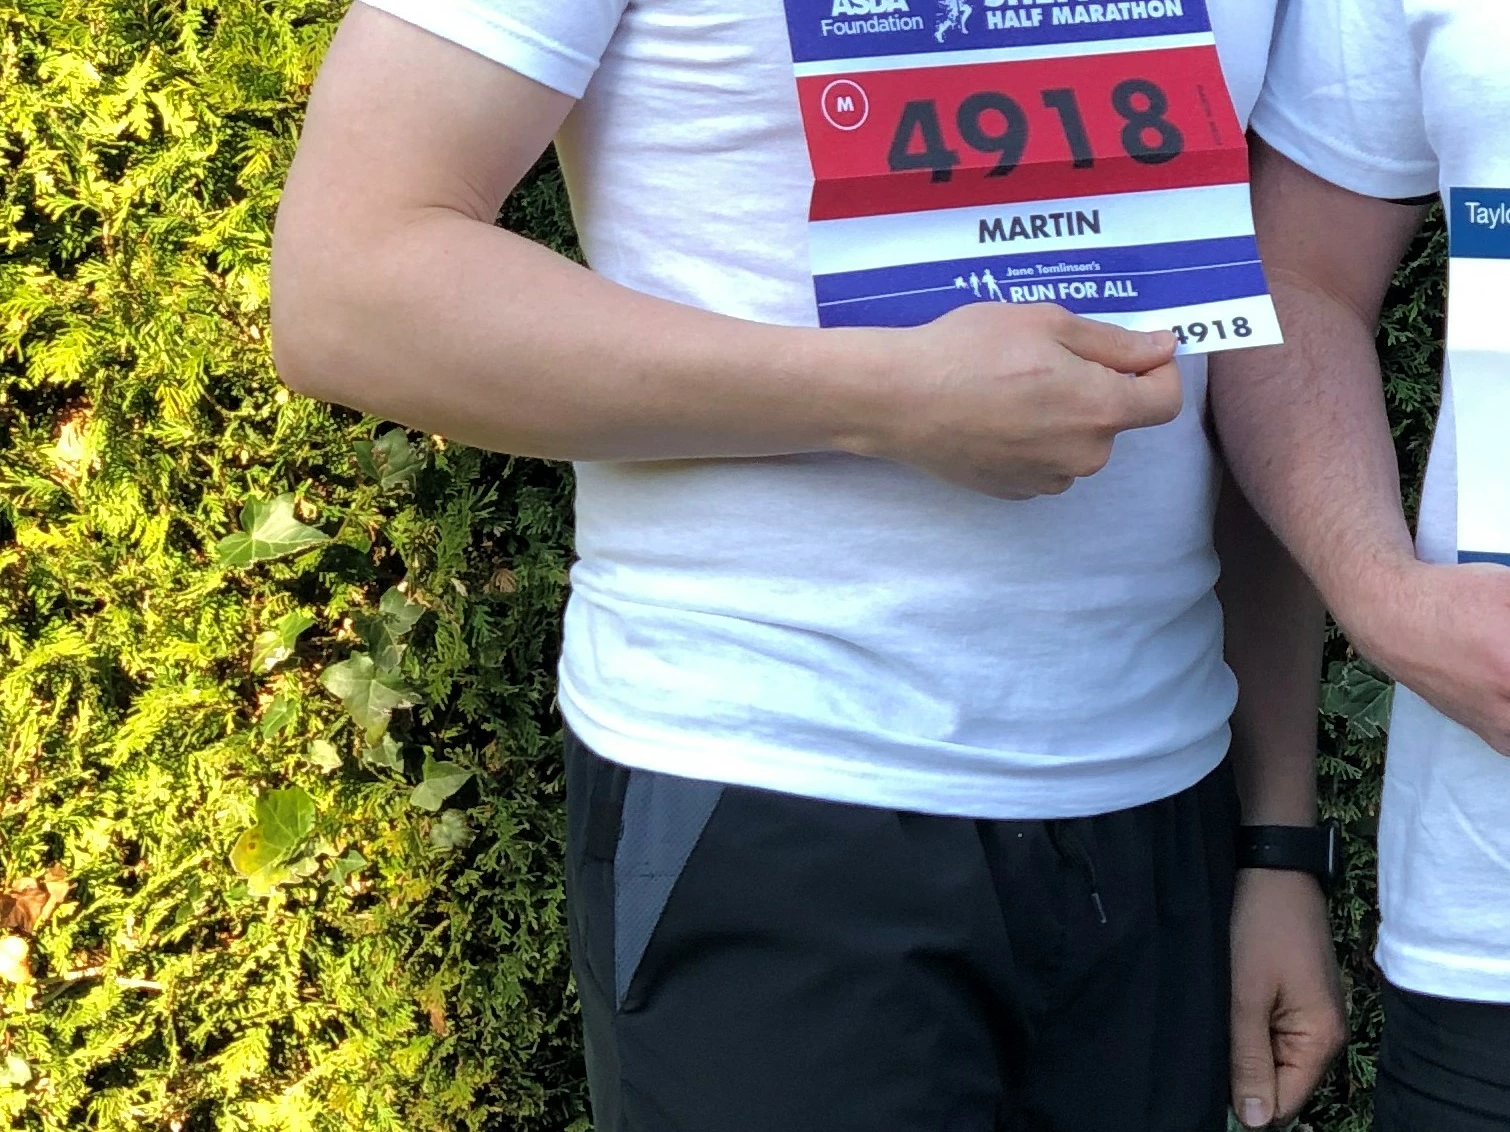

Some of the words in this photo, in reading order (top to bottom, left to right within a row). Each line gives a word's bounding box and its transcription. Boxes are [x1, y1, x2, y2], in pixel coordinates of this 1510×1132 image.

[821, 14, 924, 36] Foundation
[986, 8, 1043, 30] HALF
[837, 96, 854, 112] M
[887, 78, 1184, 183] 4918
[979, 209, 1101, 244] MARTIN
[1006, 267, 1034, 278] Jane
[1035, 261, 1101, 274] Tomlinson's
[1009, 283, 1056, 303] RUN
[1058, 281, 1099, 300] FOR
[1103, 280, 1139, 298] ALL
[1171, 316, 1252, 345] 4918
